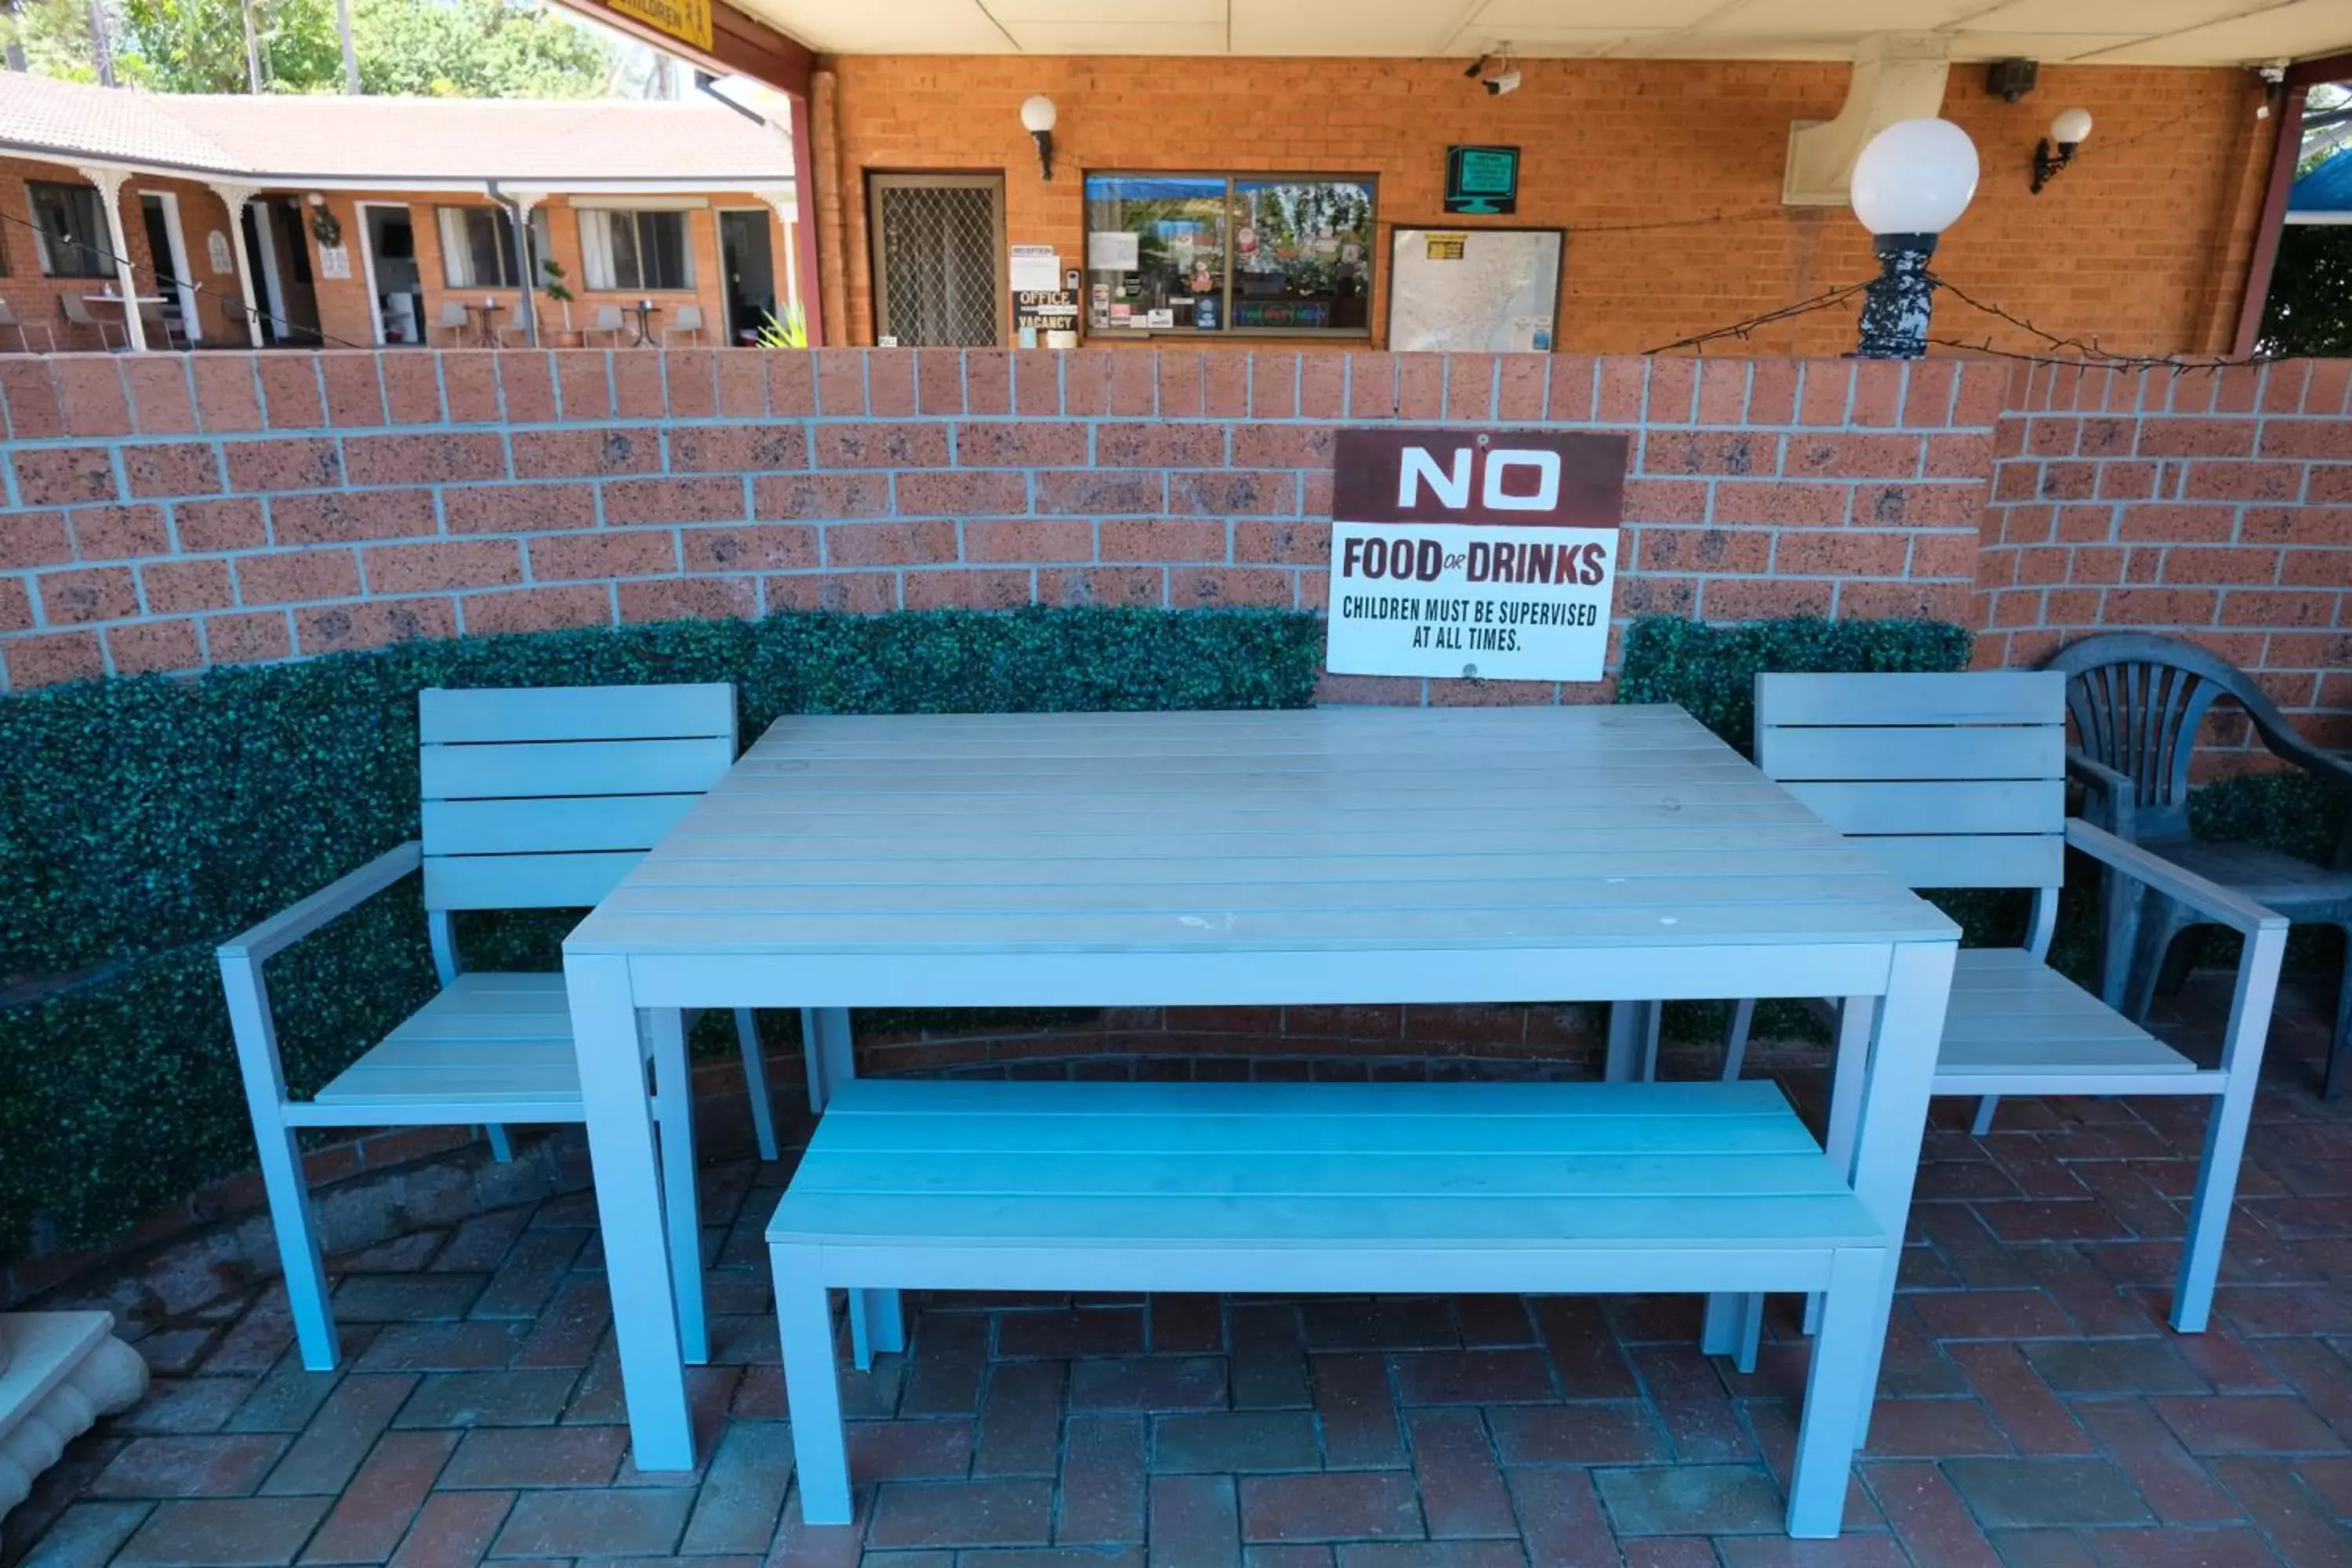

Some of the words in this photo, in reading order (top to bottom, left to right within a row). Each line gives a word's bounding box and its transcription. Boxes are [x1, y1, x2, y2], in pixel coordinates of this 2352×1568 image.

[619, 0, 682, 30] HILDREN
[1020, 291, 1070, 305] OFFICE
[1018, 315, 1073, 329] VACANCY
[1396, 445, 1562, 511] NO
[1342, 537, 1443, 582] FOOD
[1443, 553, 1466, 571] OR
[1466, 542, 1606, 586] DRINKS
[1343, 595, 1419, 621] CHILDREN
[1425, 598, 1469, 622] MUST
[1474, 601, 1494, 623] BE
[1499, 601, 1597, 626] SUPERVISED
[1412, 626, 1430, 648] AT
[1436, 626, 1462, 649] ALL
[1469, 628, 1521, 652] TIMES.
